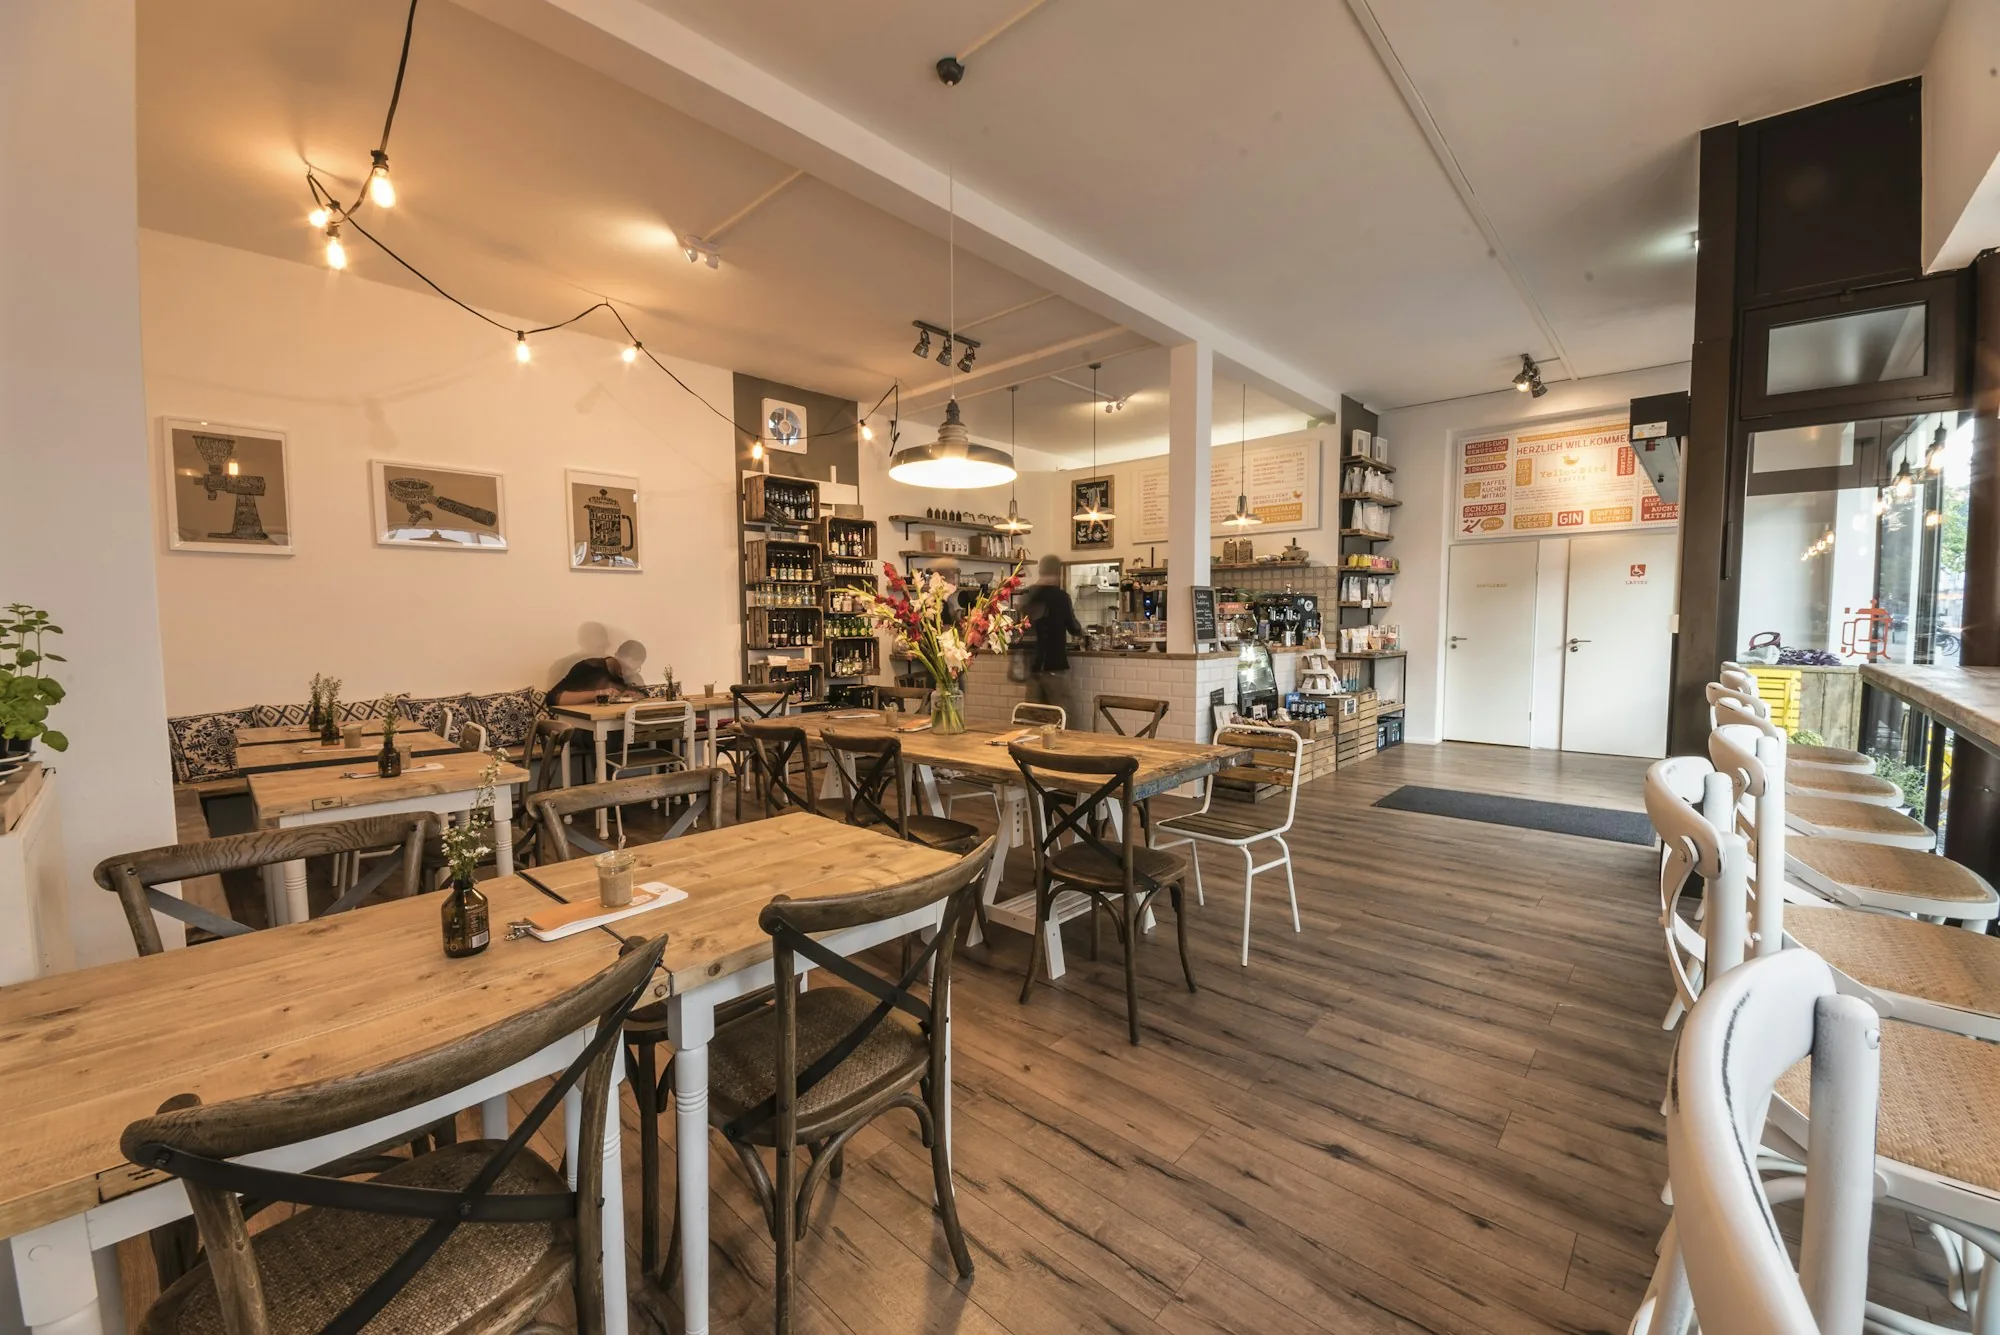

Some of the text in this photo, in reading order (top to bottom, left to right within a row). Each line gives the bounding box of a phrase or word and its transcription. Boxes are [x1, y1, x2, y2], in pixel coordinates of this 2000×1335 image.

[1516, 443, 1563, 455] HERZLICH
[1464, 503, 1505, 513] SCHÖNES
[1515, 513, 1550, 522] COFFEE
[1559, 512, 1582, 525] GIN
[1516, 520, 1549, 528] EVENTS
